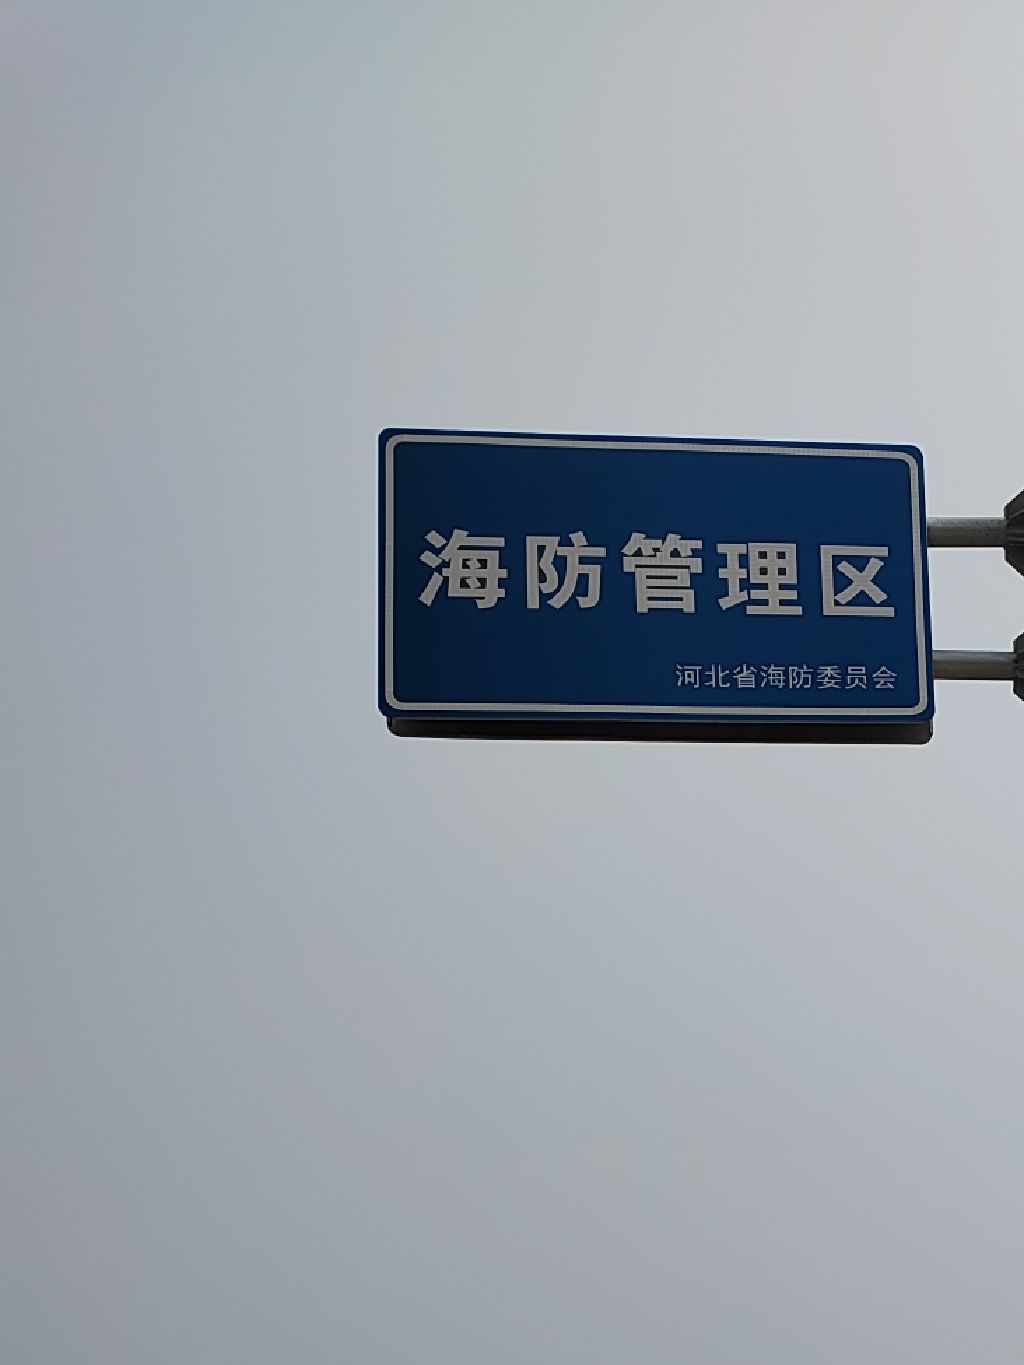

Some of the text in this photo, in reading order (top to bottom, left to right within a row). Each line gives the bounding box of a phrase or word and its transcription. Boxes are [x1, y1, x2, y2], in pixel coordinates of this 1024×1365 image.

[418, 528, 896, 618] 海防管理区
[675, 662, 898, 690] 河北省海防委员会
